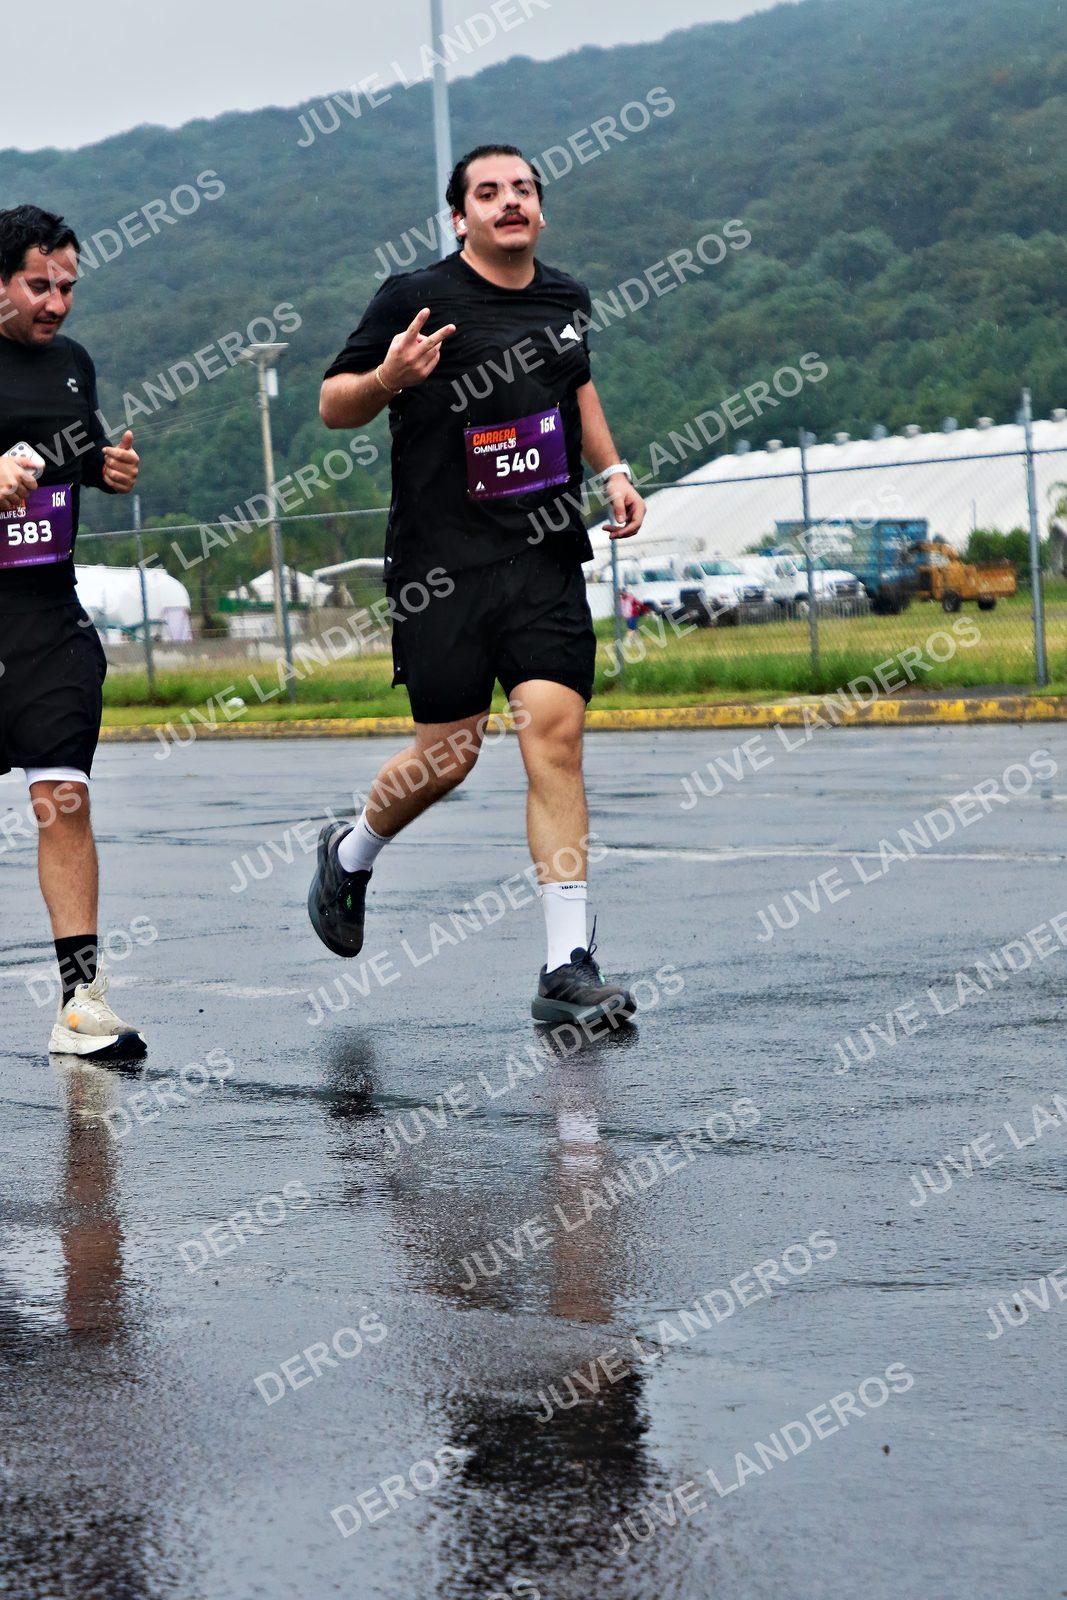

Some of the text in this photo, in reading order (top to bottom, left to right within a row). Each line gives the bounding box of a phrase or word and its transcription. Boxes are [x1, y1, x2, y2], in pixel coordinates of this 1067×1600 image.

[472, 427, 517, 446] CARRERA
[496, 448, 540, 477] 540
[7, 520, 53, 546] 583
